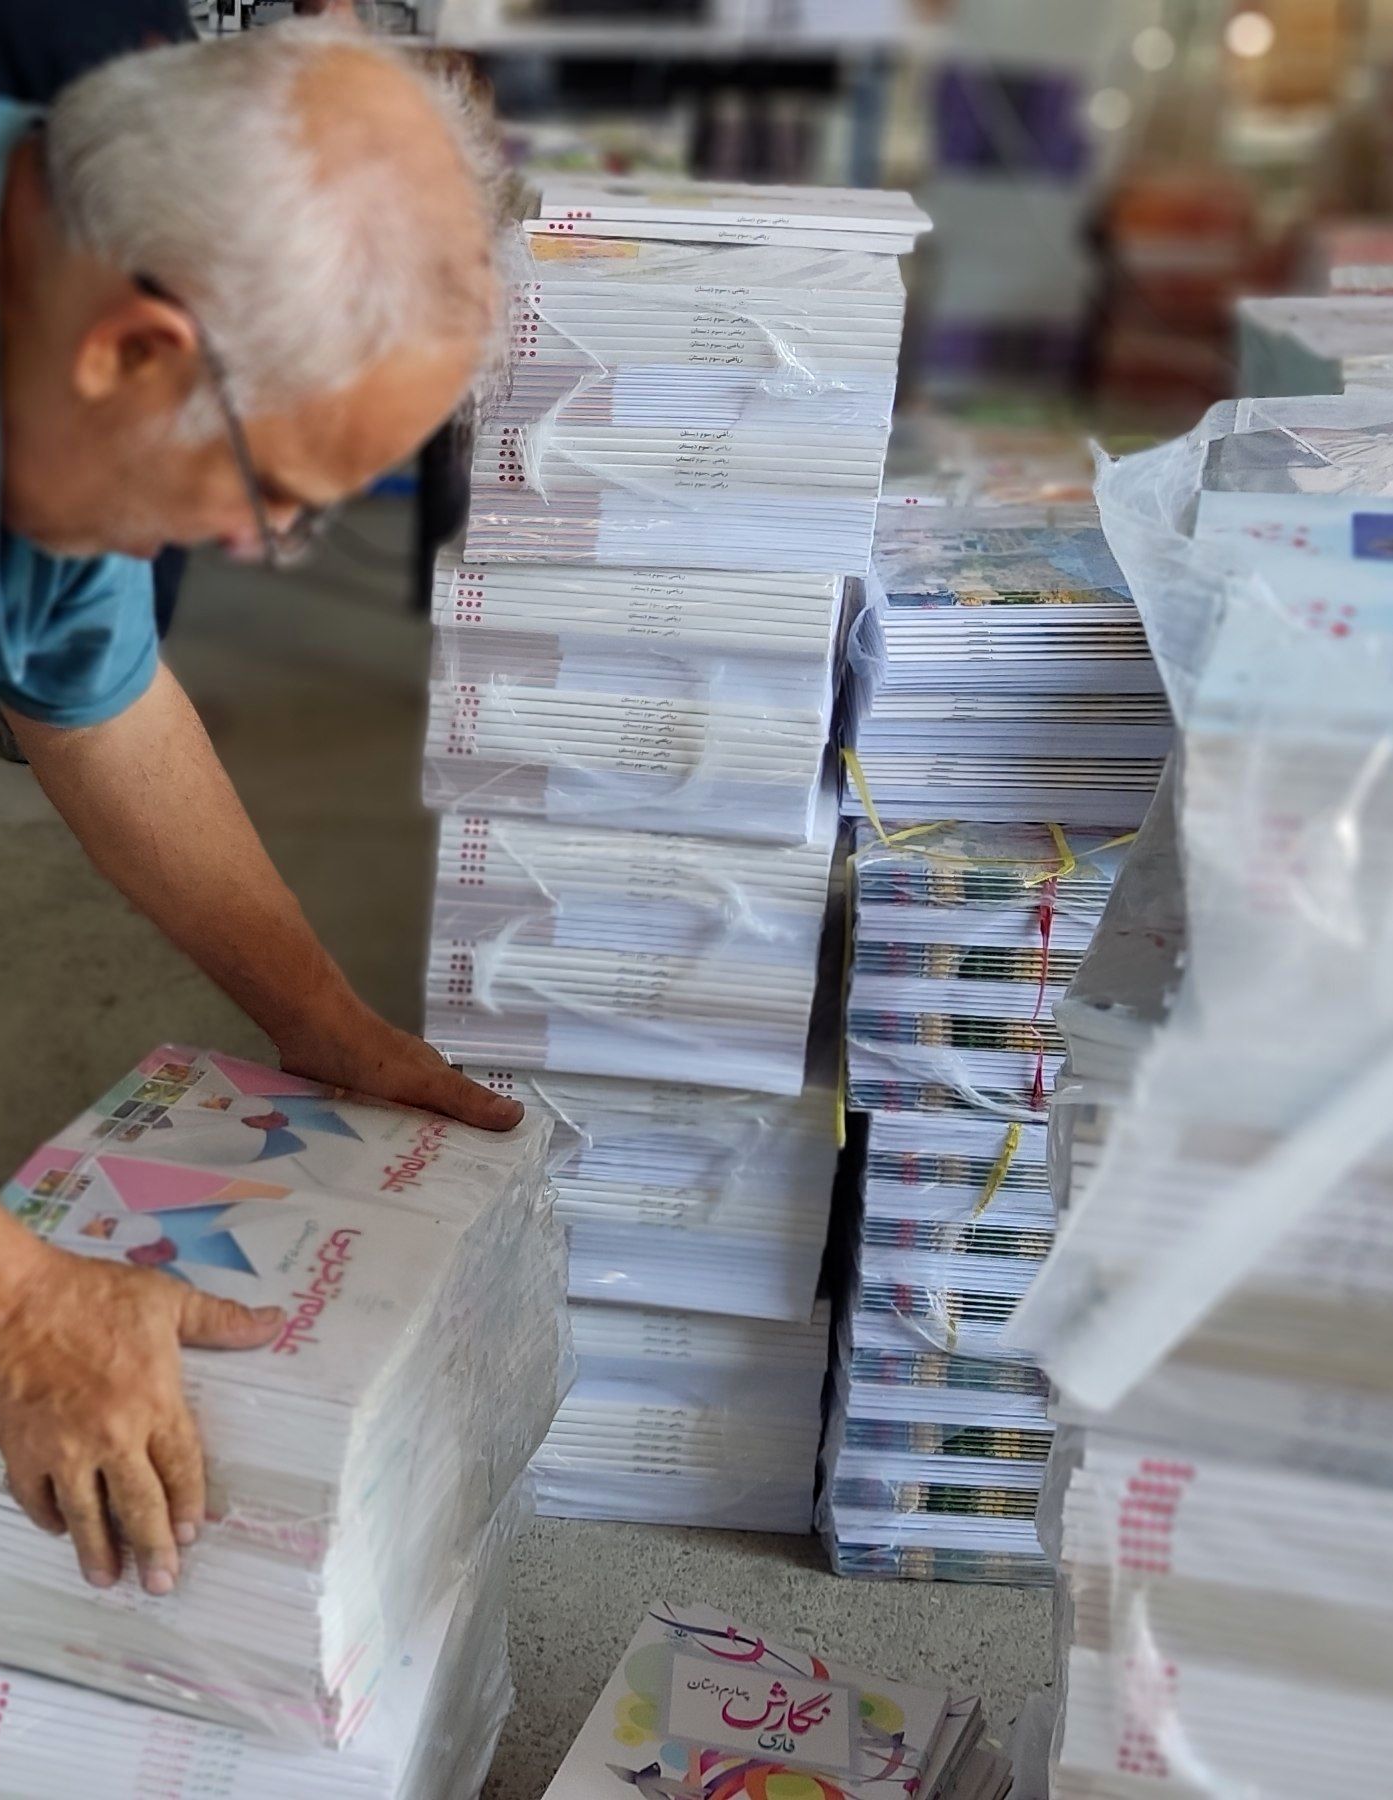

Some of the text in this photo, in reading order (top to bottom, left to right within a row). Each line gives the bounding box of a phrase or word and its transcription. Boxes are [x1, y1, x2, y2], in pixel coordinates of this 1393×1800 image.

[687, 1677, 751, 1701] چهارم دبستان
[721, 1681, 833, 1734] نگارش
[757, 1733, 795, 1753] فارسی
